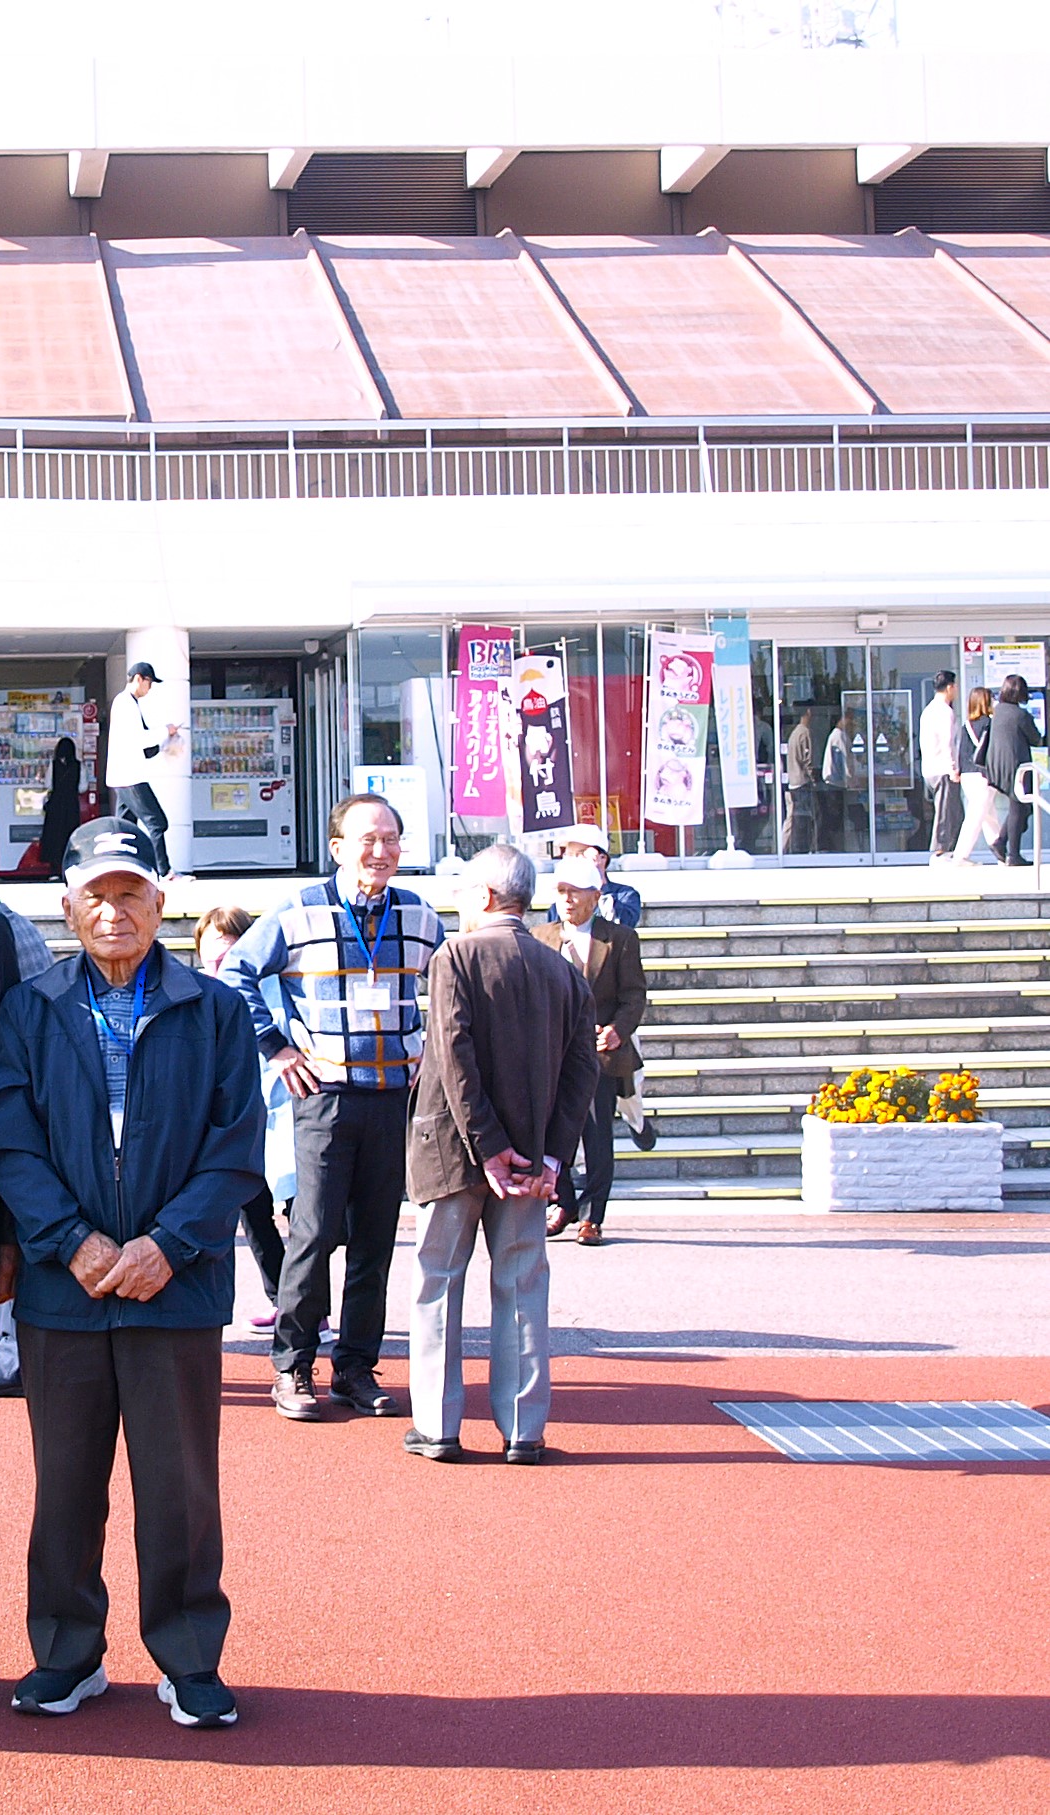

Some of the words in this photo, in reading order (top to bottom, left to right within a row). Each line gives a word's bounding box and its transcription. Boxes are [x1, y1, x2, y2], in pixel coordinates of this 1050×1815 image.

[462, 688, 483, 798] アイスクリーム
